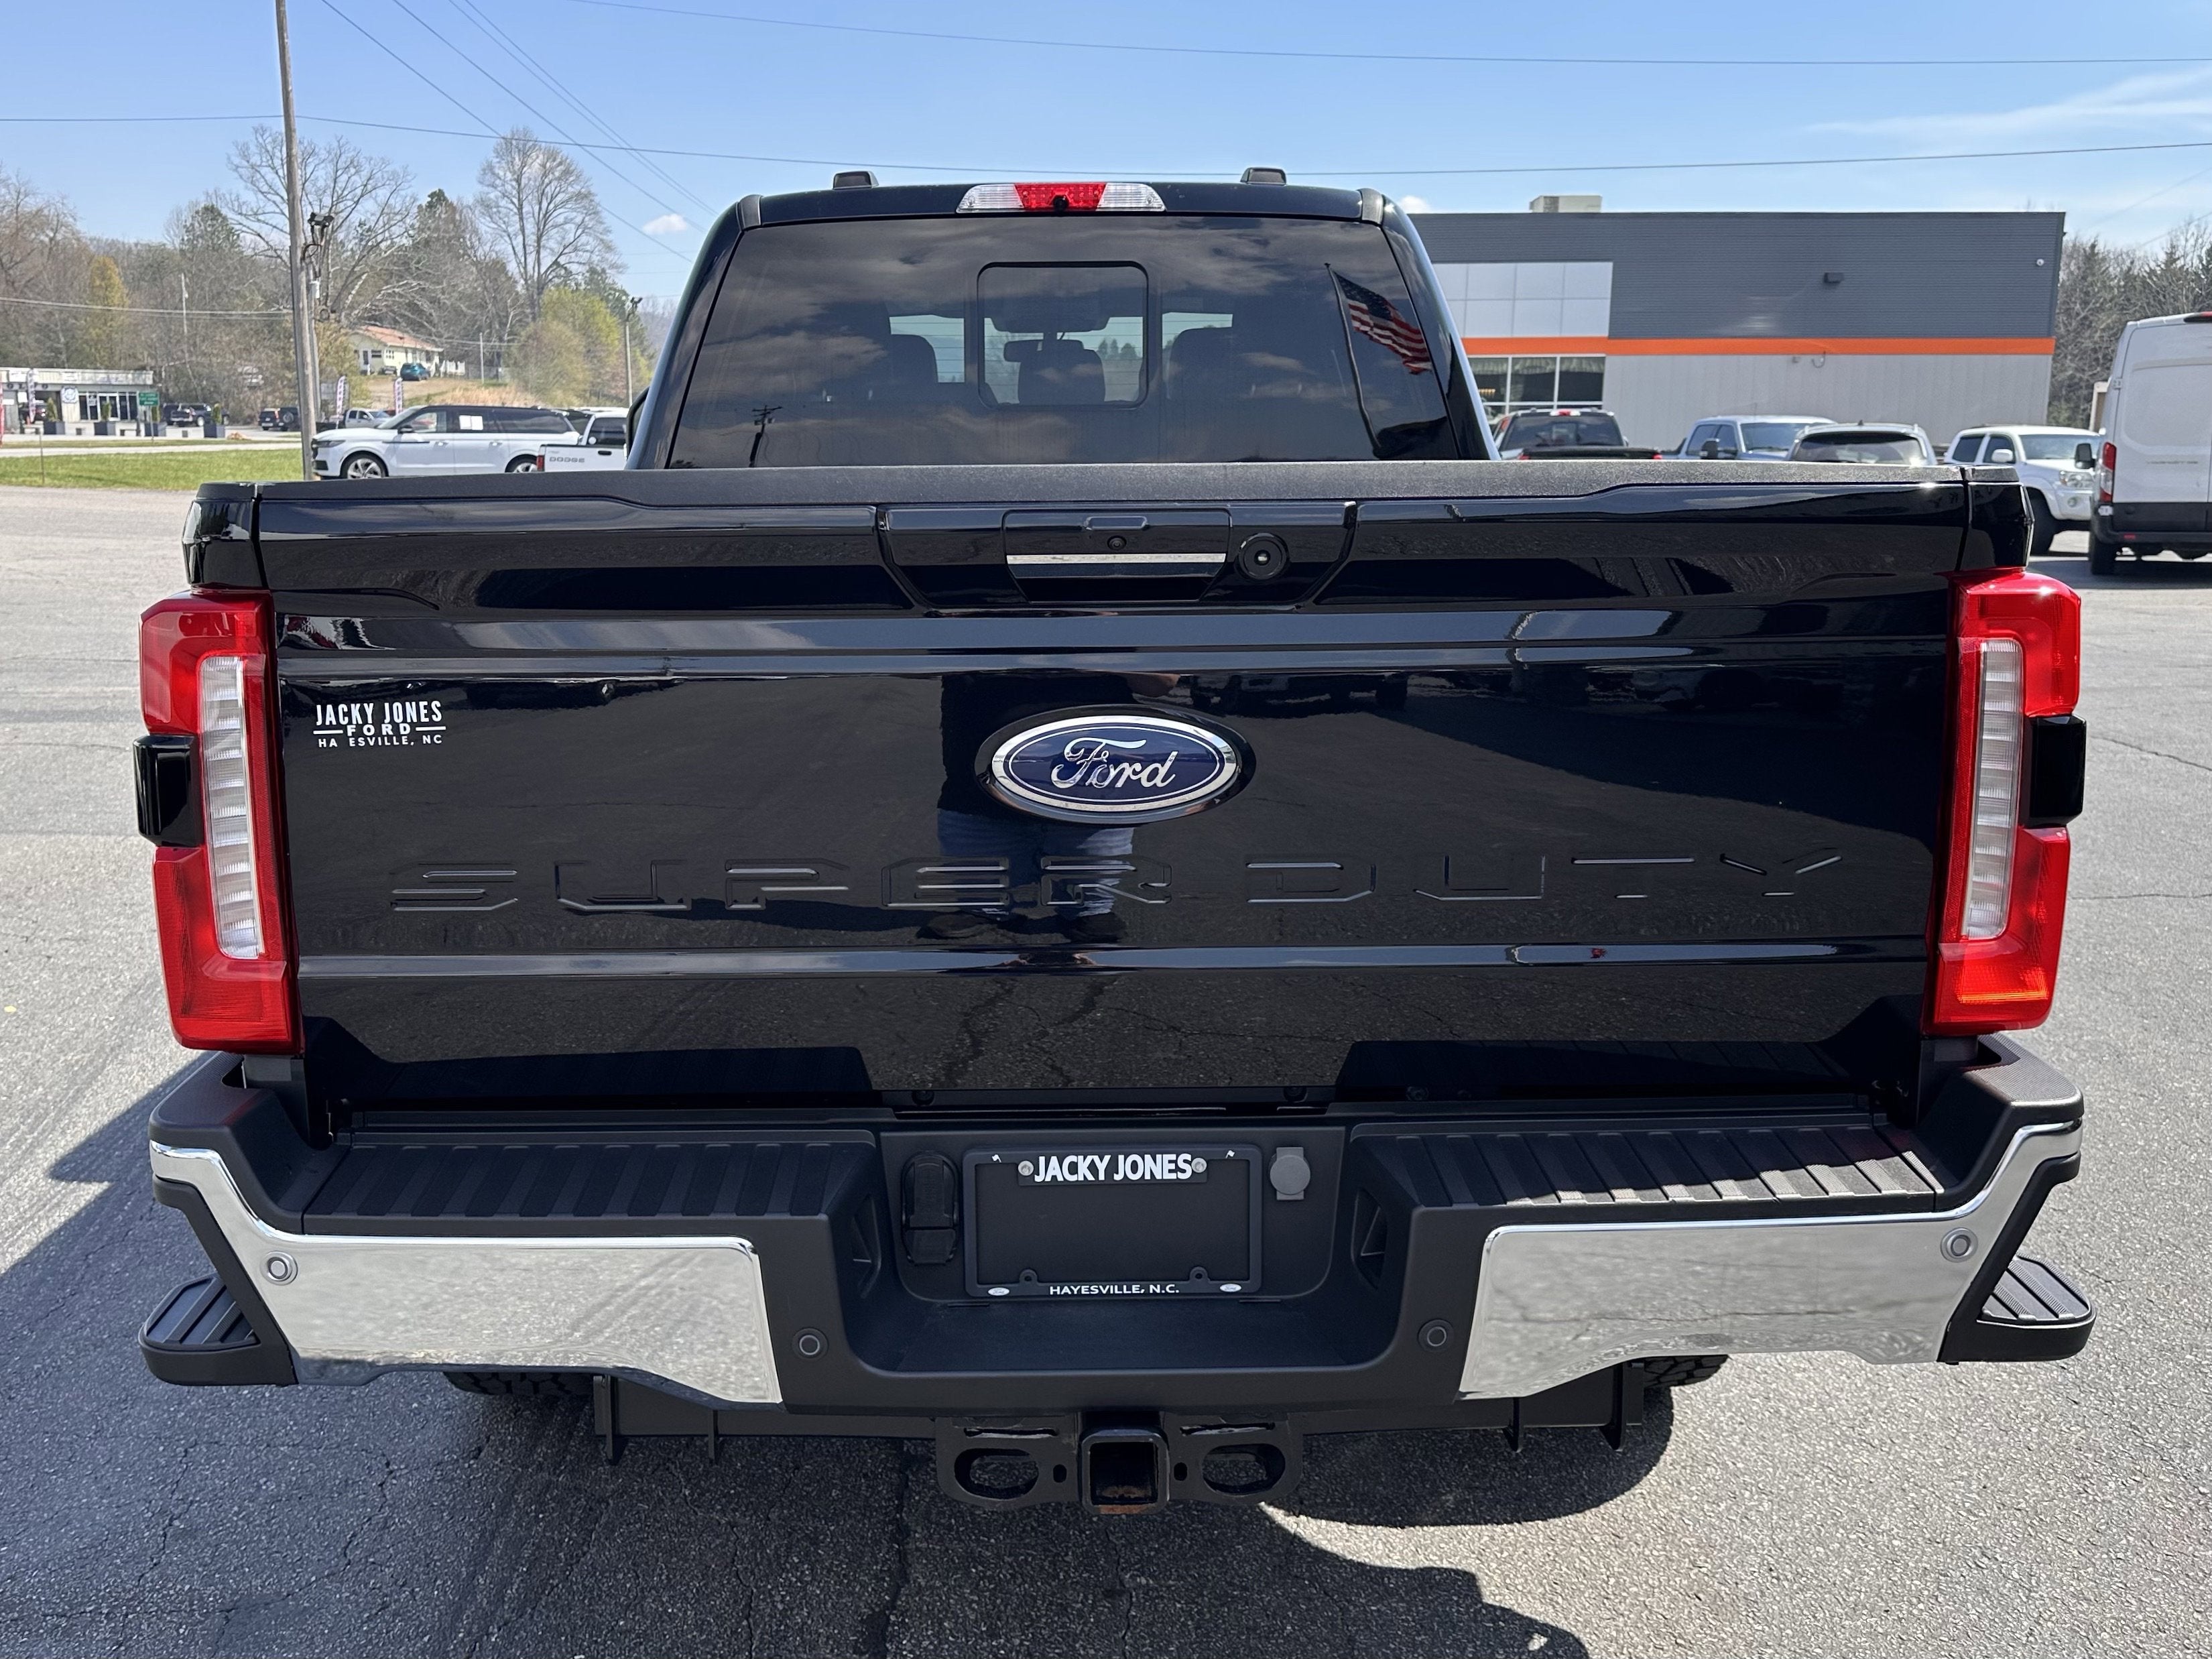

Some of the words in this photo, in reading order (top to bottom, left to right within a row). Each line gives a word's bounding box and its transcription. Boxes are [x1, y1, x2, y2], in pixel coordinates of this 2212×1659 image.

[316, 702, 374, 726] JACKY
[384, 700, 442, 724] JONES
[347, 723, 411, 737] FORD
[422, 734, 442, 745] NC
[1050, 737, 1179, 789] Ford
[389, 856, 1172, 912] SUPER
[1243, 847, 1843, 904] DUTY
[1034, 1154, 1112, 1182] JACKY
[1113, 1153, 1192, 1181] JONES
[1049, 1284, 1146, 1295] HAYESVILLE,
[1149, 1283, 1180, 1294] N.C.
